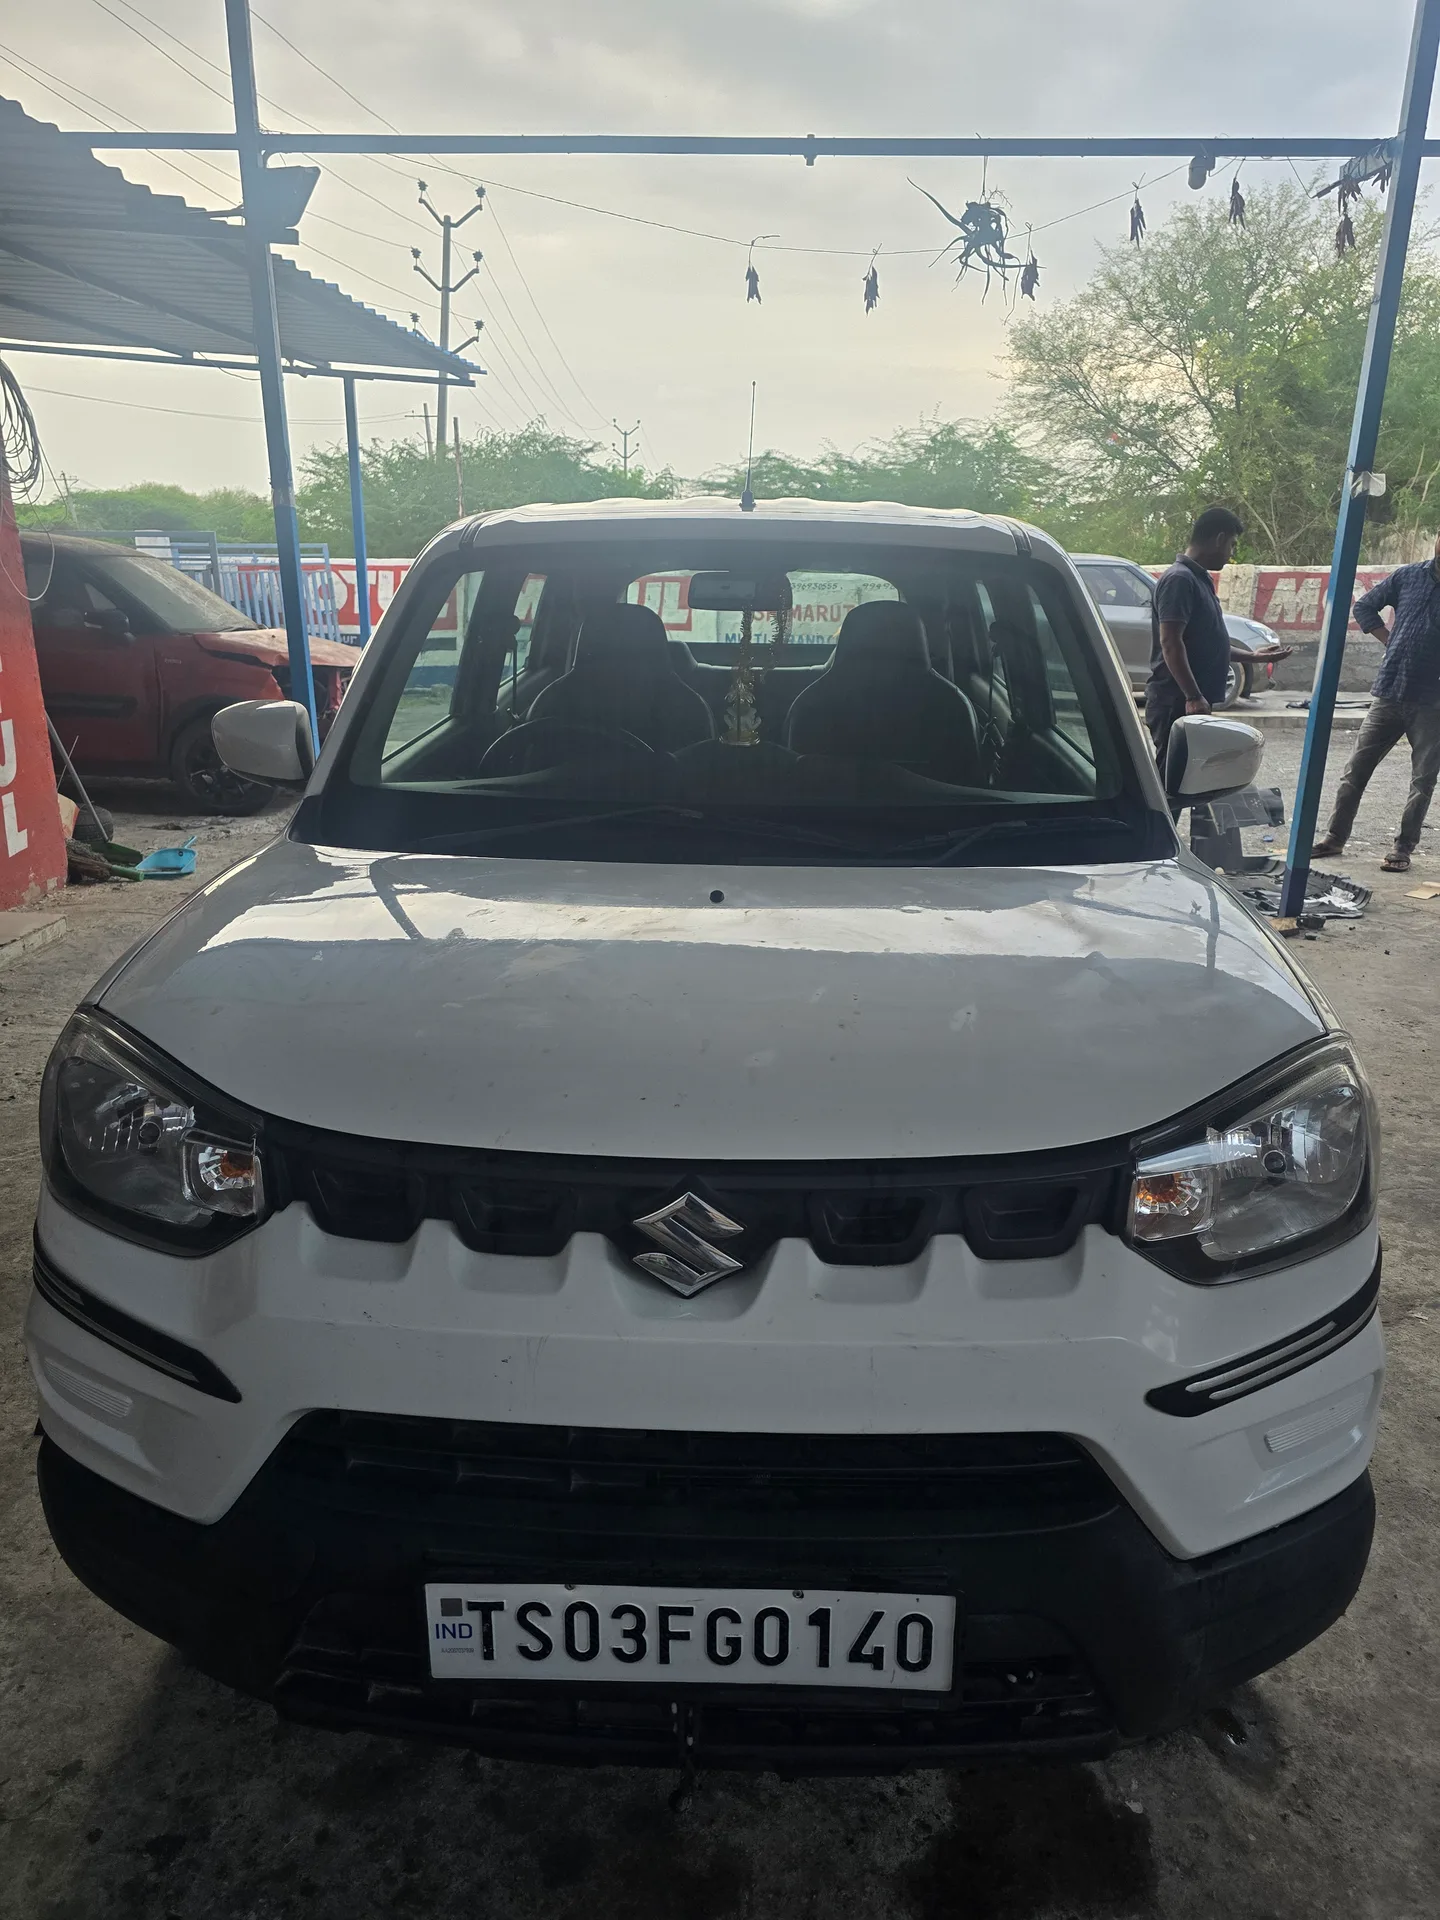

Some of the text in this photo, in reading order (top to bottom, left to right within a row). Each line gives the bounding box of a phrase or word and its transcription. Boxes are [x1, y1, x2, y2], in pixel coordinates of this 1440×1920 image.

[791, 604, 855, 622] MARUT
[435, 1623, 473, 1639] IND
[466, 1600, 934, 1672] TS03FG0140
